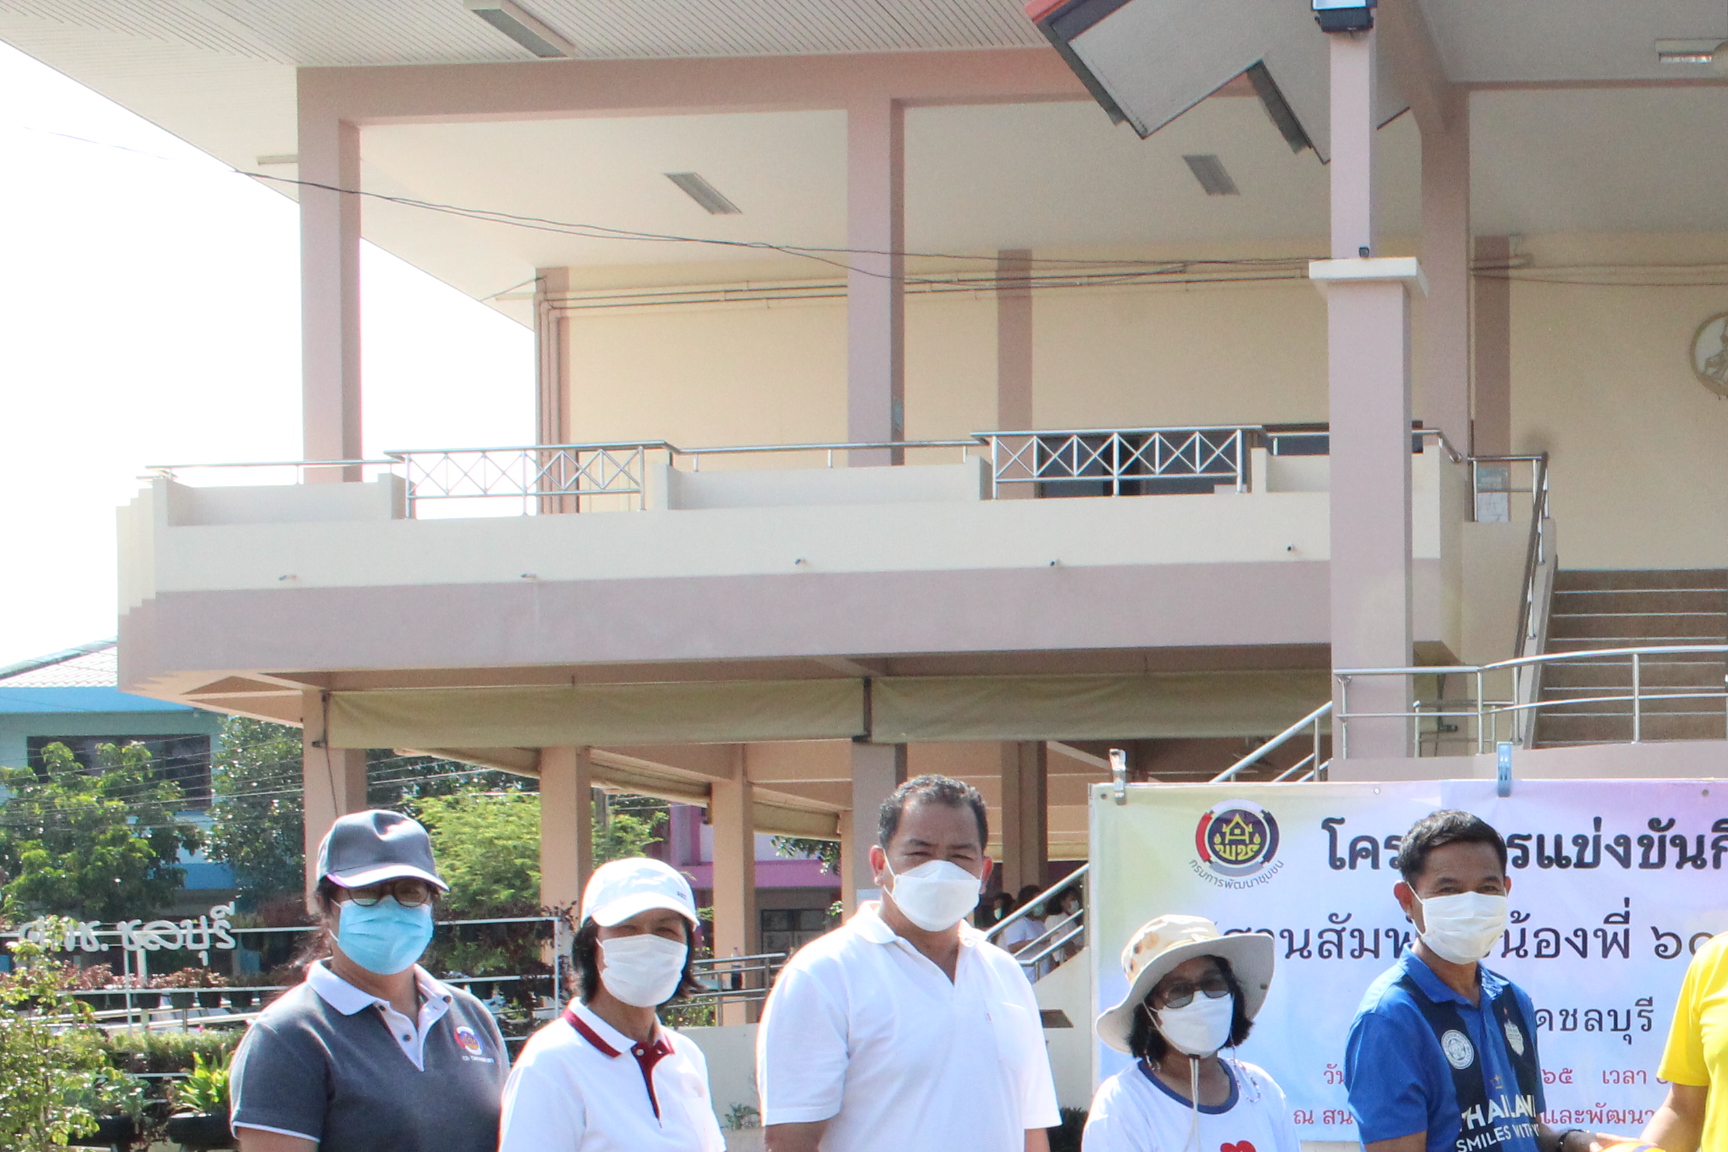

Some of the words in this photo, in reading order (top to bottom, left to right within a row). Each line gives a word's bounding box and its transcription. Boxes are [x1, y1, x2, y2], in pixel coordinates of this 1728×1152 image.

[1188, 857, 1285, 891] กรมการพัฒนาชุมชน
[1534, 997, 1654, 1045] ดชลบุรี
[1602, 1069, 1647, 1085] เวลา
[1293, 1109, 1315, 1125] ณ
[1322, 1109, 1354, 1125] สน
[1543, 1102, 1656, 1125] และพัฒนา
